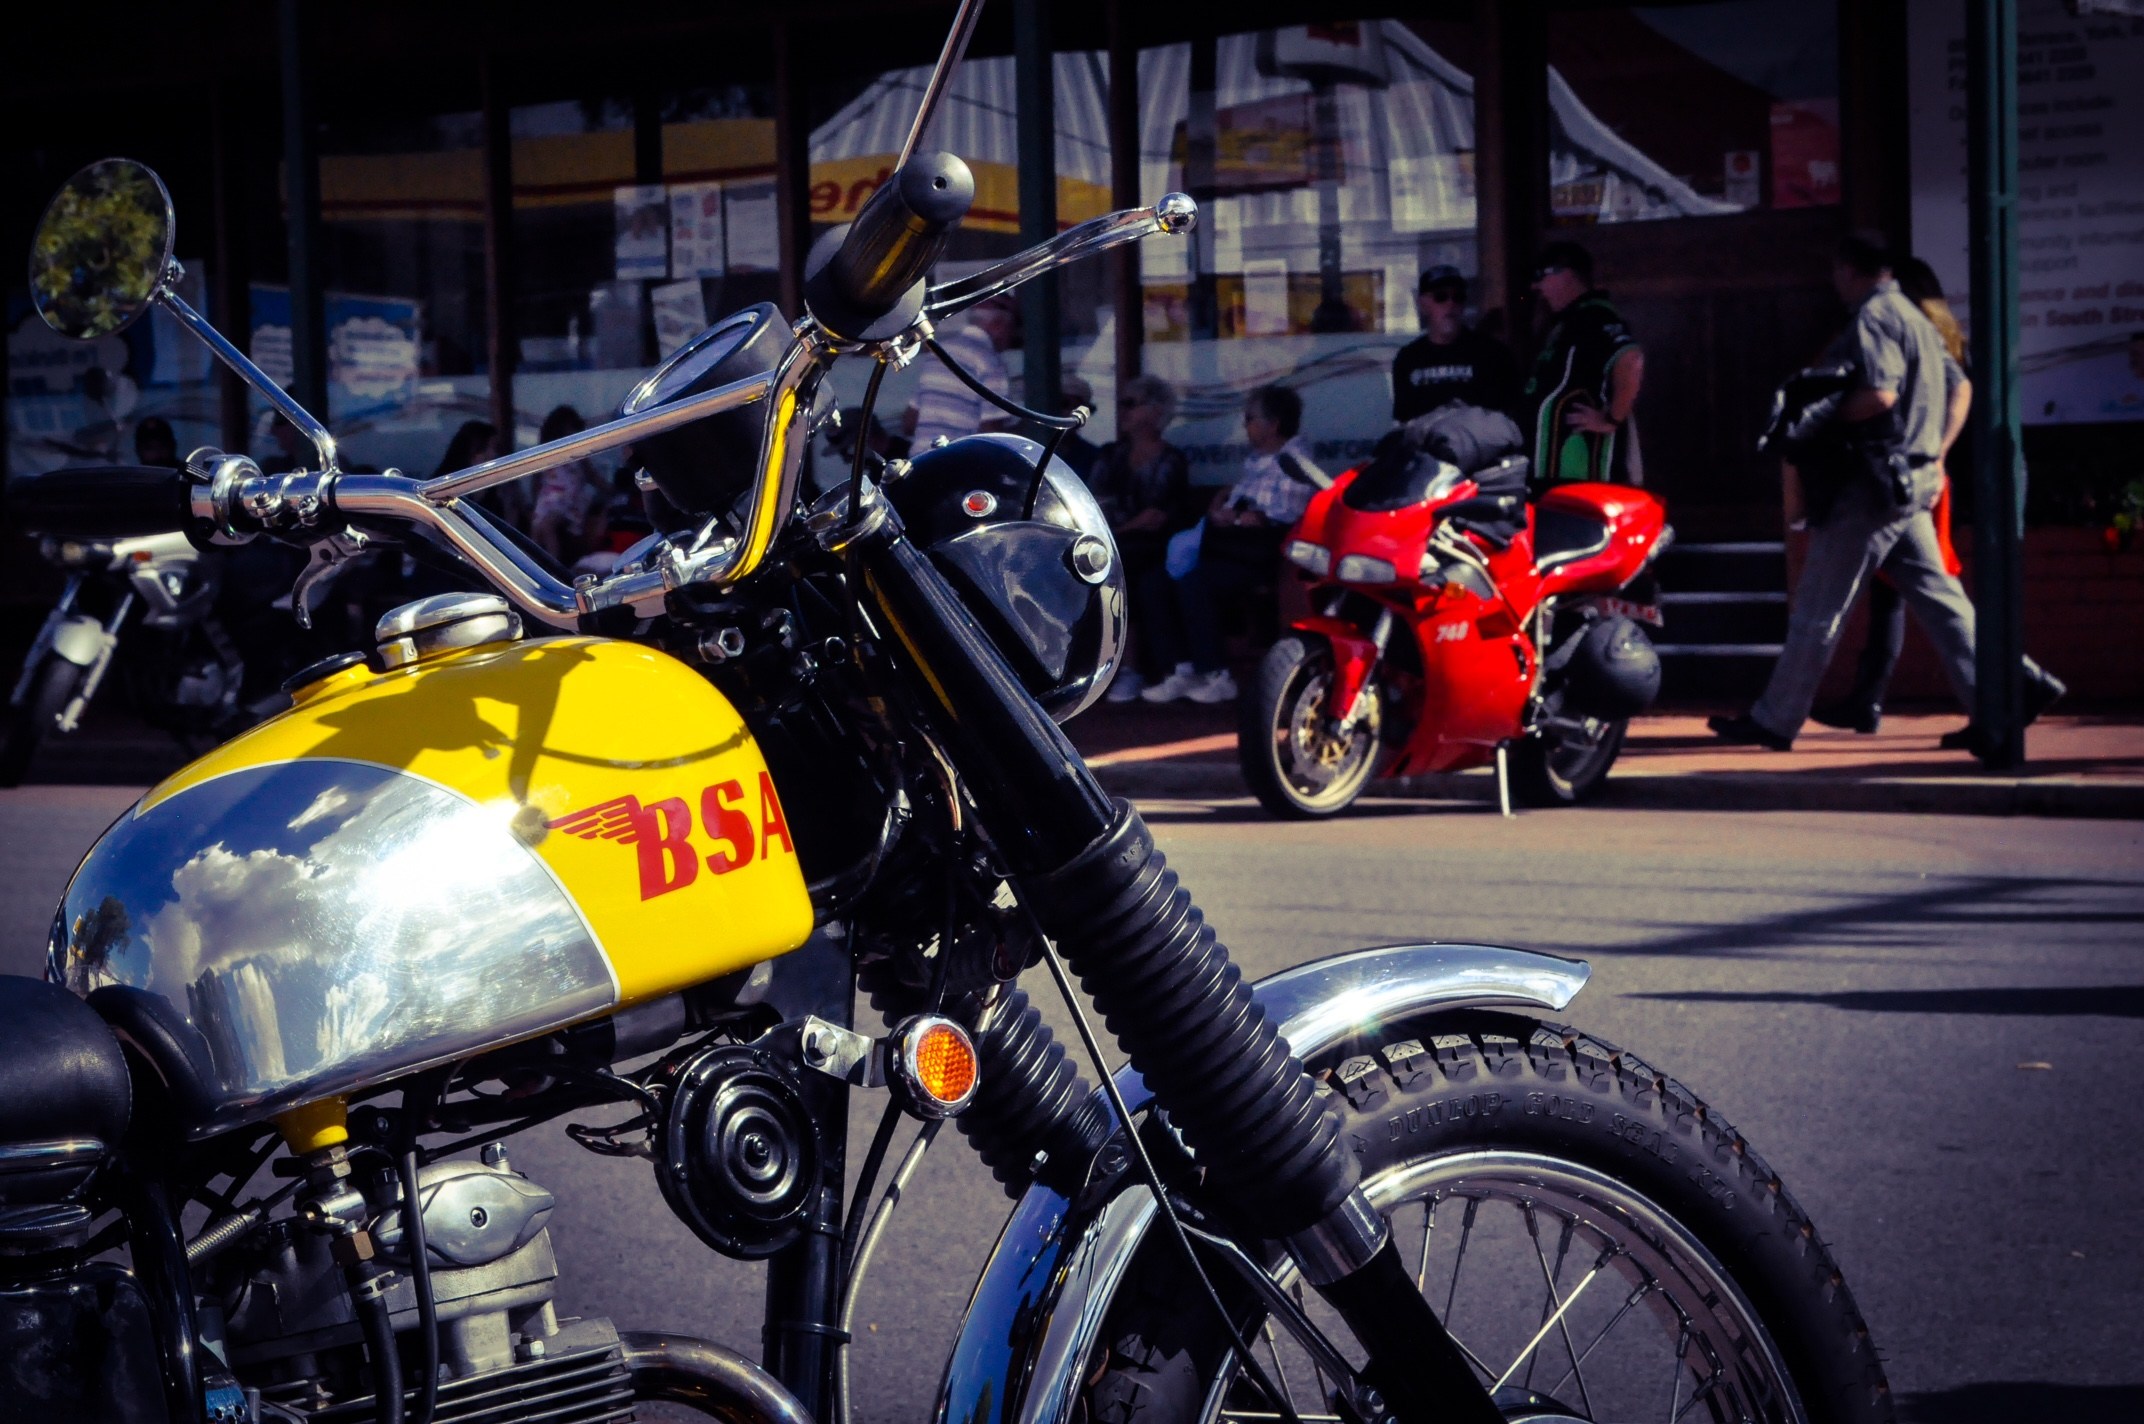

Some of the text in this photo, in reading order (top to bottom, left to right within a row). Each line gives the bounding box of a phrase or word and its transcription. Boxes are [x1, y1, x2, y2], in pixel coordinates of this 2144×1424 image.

[636, 771, 794, 901] BSA
[1387, 1092, 1502, 1143] DUNLOP
[1523, 1090, 1596, 1125] GOLD
[1606, 1112, 1679, 1167] SEAL
